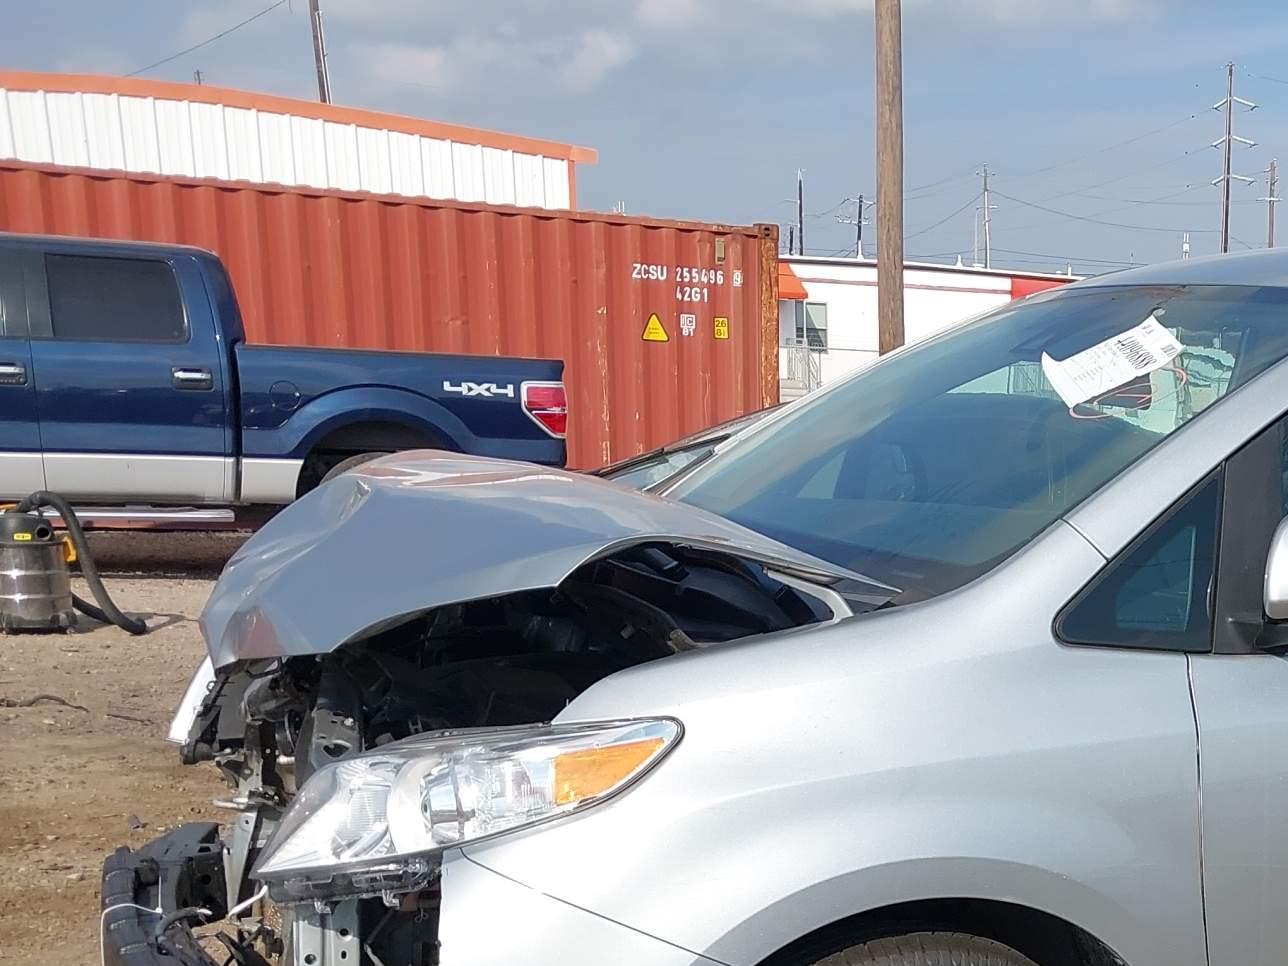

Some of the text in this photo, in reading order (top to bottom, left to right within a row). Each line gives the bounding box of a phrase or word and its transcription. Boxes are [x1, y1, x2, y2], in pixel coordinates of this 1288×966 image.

[631, 263, 667, 280] ZCSU
[676, 267, 724, 284] 255496
[676, 286, 708, 302] 42G1
